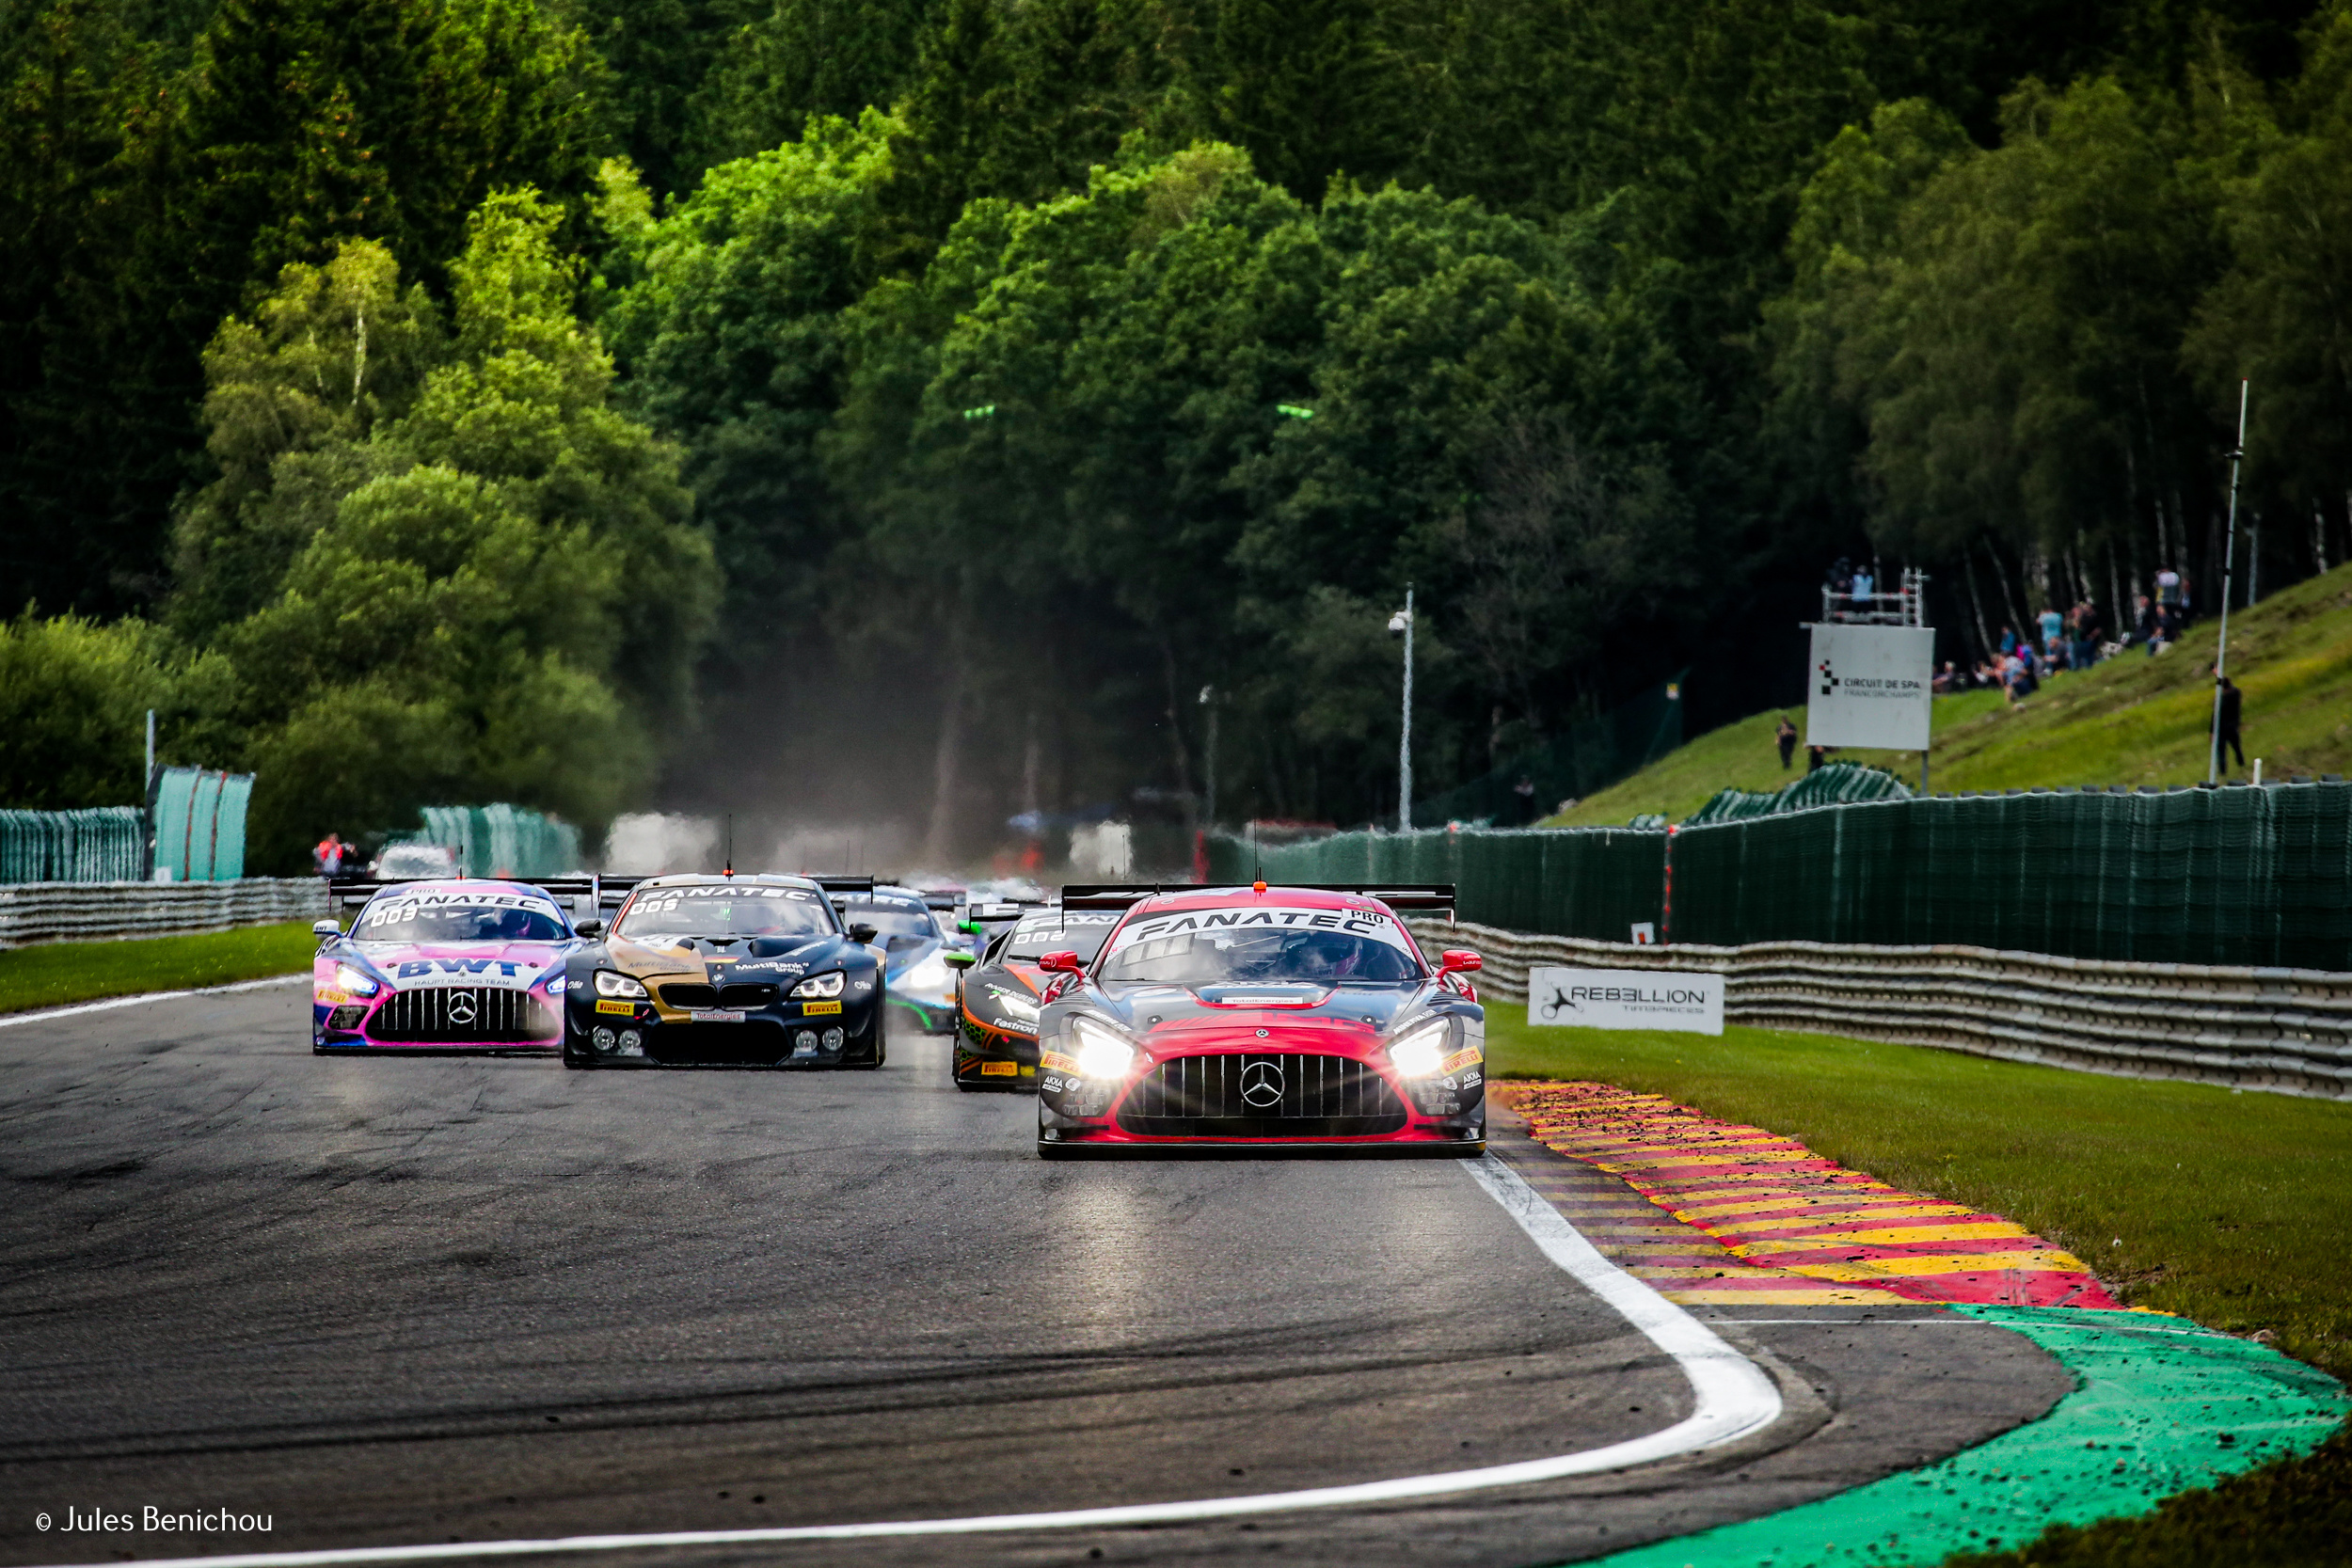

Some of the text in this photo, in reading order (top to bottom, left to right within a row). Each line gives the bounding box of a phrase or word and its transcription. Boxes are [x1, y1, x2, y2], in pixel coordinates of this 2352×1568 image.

[1844, 677, 1921, 689] CIRCUIT DE SPA
[642, 887, 815, 902] FANATEC
[379, 895, 541, 911] FANATEC
[628, 898, 679, 916] 005
[370, 907, 419, 927] 003
[1351, 910, 1384, 924] PRO
[1136, 911, 1376, 942] FANATEC
[1013, 929, 1067, 944] 002
[397, 958, 523, 979] BWT
[735, 961, 803, 972] MultiBank
[774, 966, 806, 976] Group
[1571, 987, 1705, 1004] REBELLION
[599, 1003, 630, 1013] PIRELLI
[807, 1004, 839, 1013] PIRELLI
[696, 1012, 741, 1021] TotalEnergies
[993, 1017, 1039, 1036] Fastron
[1392, 1014, 1427, 1036] MINERVA
[1043, 1053, 1082, 1074] PIRELLI
[1442, 1049, 1480, 1072] PIRELLI
[985, 1064, 1014, 1073] PIRELLI
